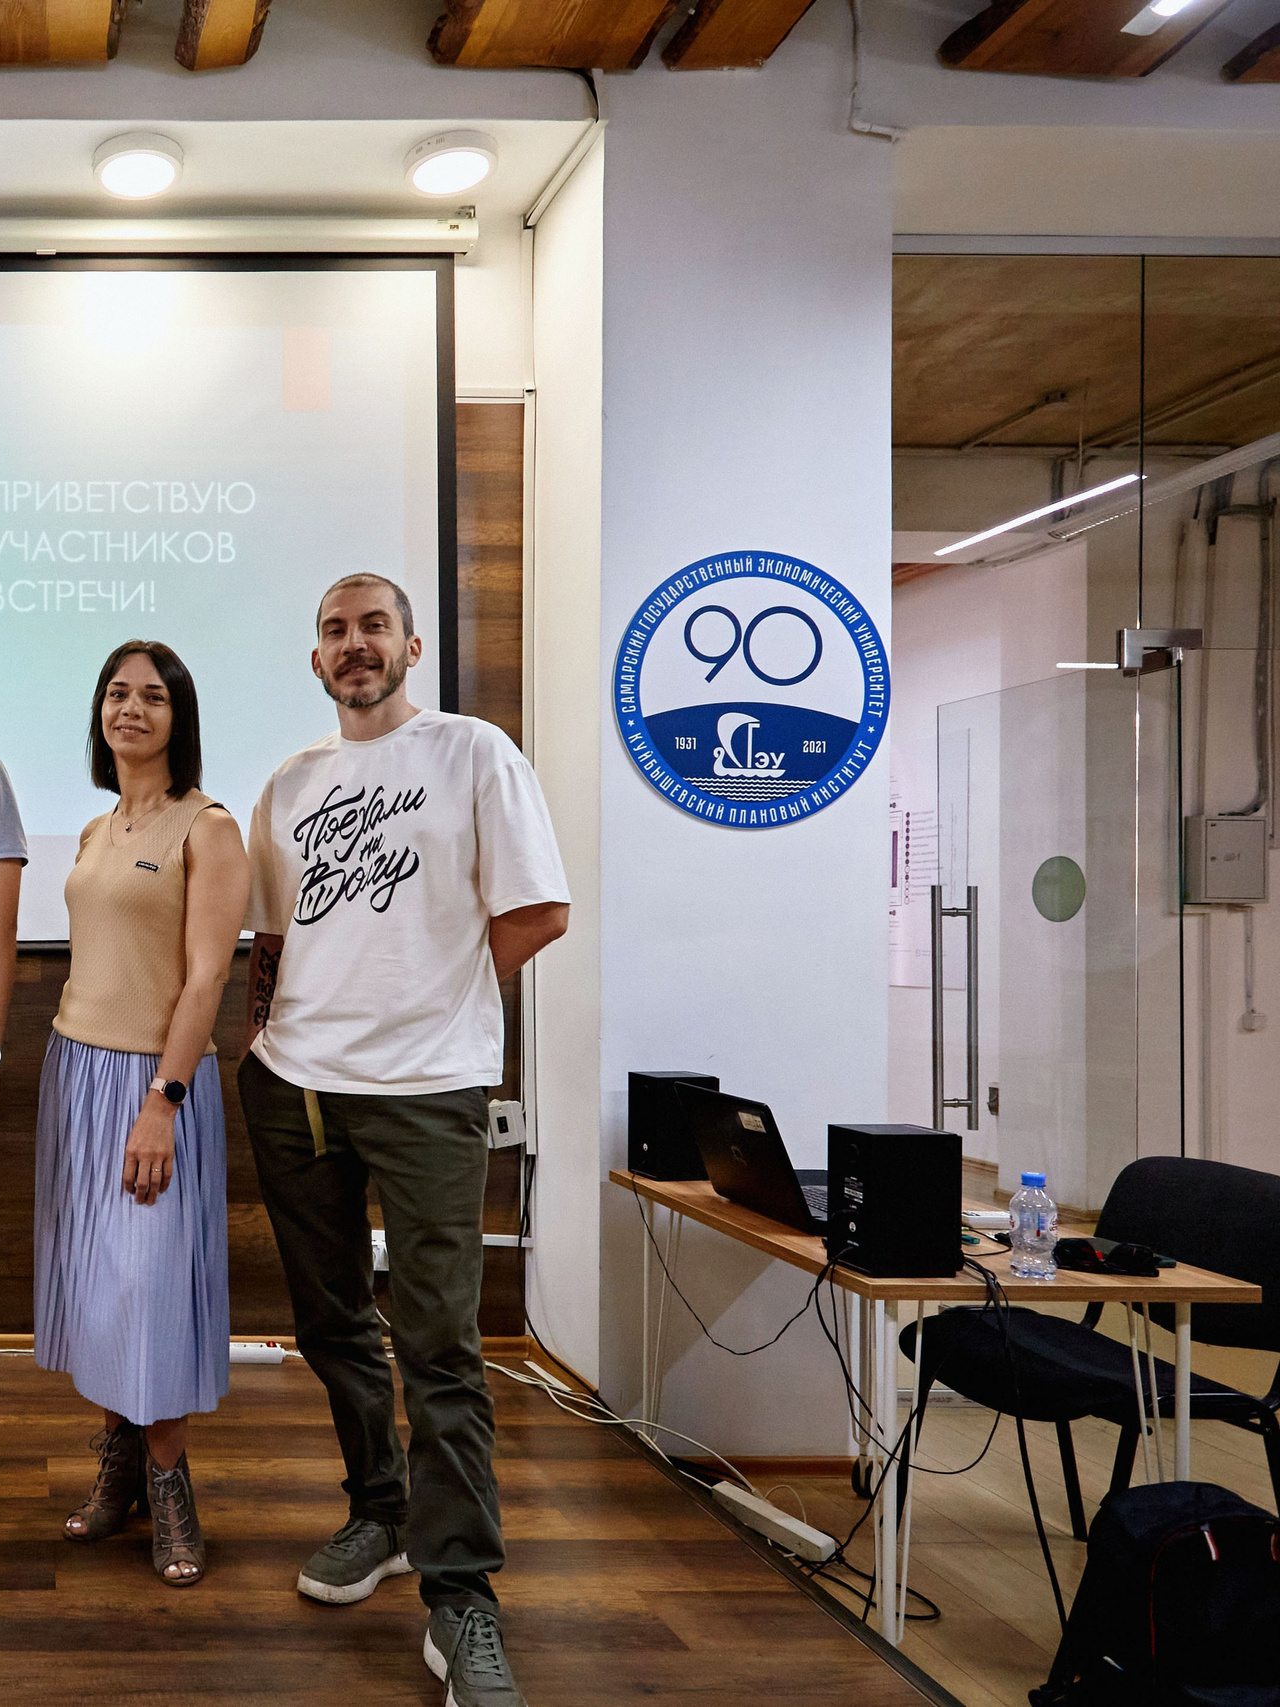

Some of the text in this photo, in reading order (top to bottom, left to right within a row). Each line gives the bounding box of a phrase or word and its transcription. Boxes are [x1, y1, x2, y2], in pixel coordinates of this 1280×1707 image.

[620, 556, 885, 719] САМАРСКИЙ ГОСУДАРСТВЕННЫЙ ЭКОНОМИЧЕСКИЙ УНИВЕРСИТЕТ
[683, 604, 823, 687] 90
[628, 732, 873, 824] КУЙБЫШЕВСКИЙ ПЛАНОВЫЙ ИНСТИТУТ
[674, 736, 697, 750] 1931
[802, 740, 827, 754] 2021
